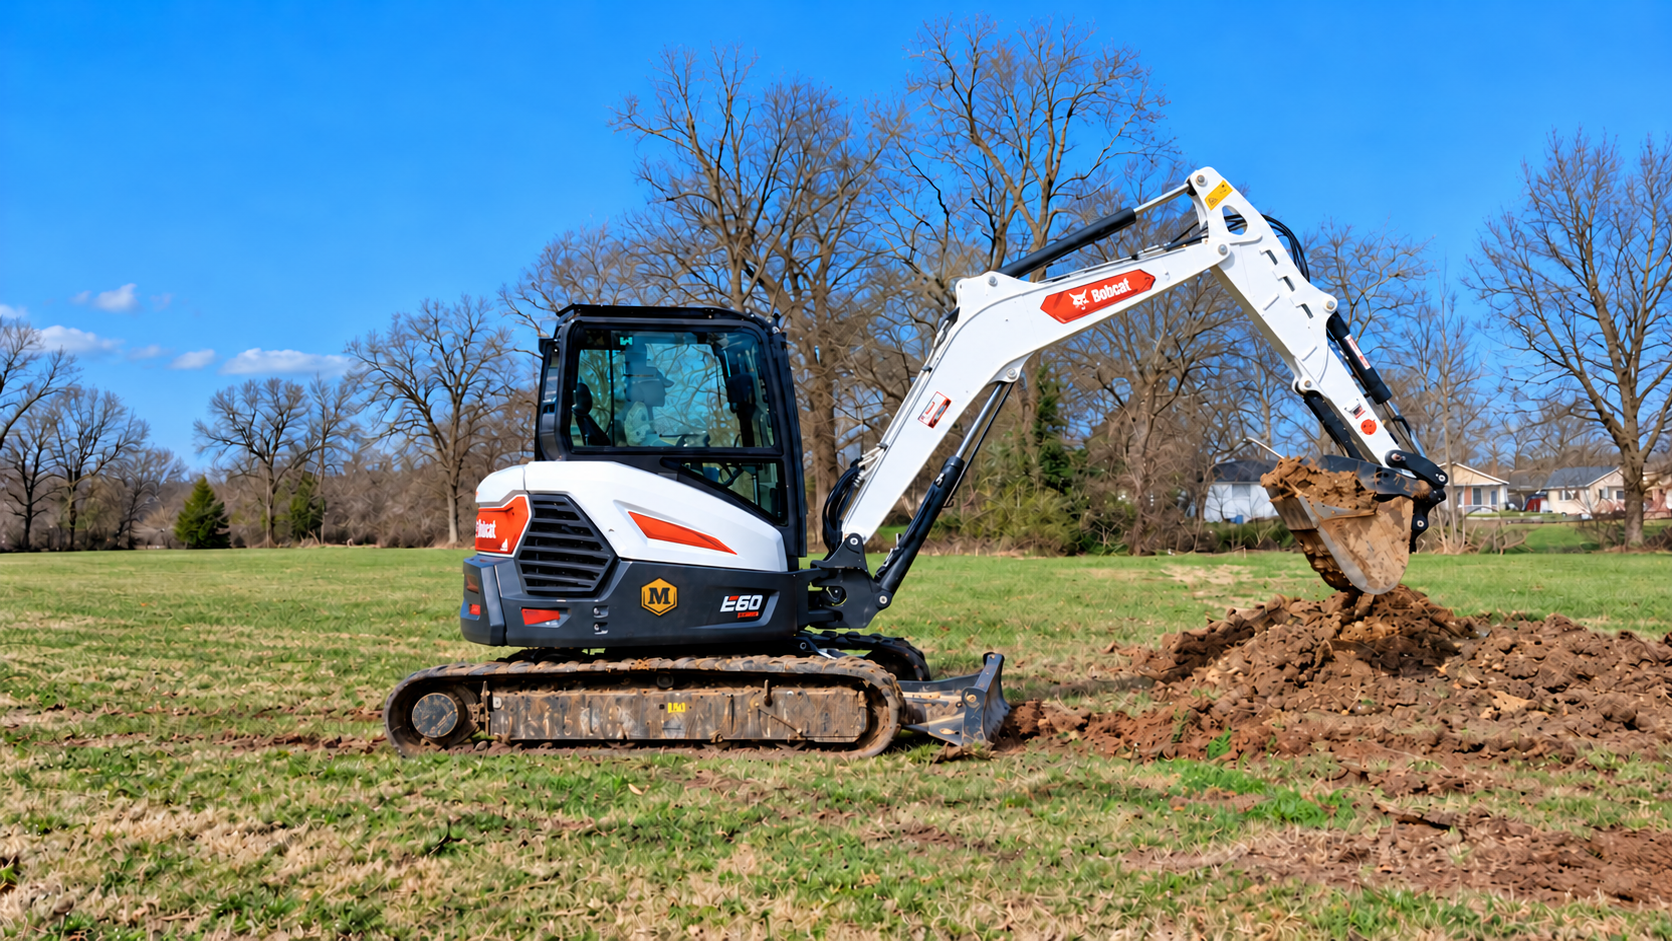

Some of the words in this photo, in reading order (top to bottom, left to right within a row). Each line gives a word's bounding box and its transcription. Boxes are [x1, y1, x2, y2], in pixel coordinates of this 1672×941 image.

[1091, 278, 1132, 303] Bobcat
[647, 587, 671, 605] M
[720, 594, 763, 612] E60
